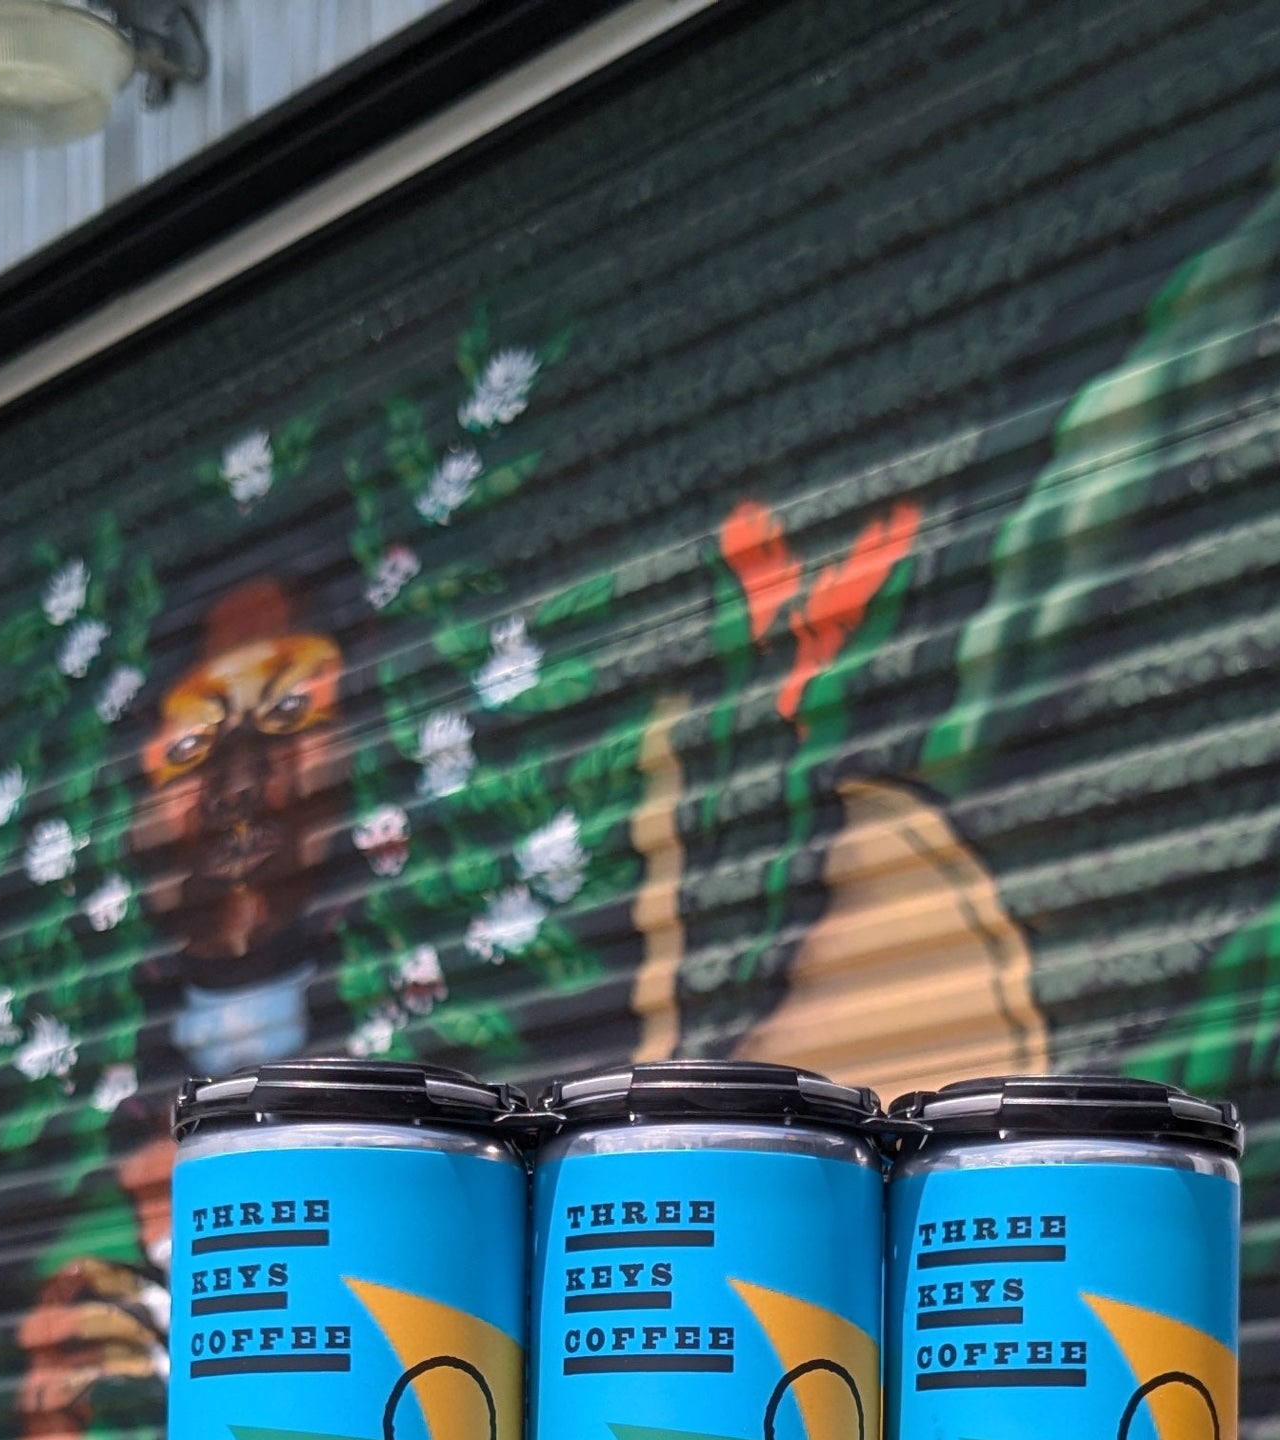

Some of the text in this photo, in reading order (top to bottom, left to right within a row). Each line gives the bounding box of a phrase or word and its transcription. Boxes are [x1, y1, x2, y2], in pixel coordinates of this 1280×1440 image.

[192, 1199, 330, 1231] THREE
[567, 1200, 715, 1229] THREE
[918, 1215, 1066, 1246] THREE
[192, 1262, 289, 1294] KEYS
[566, 1262, 673, 1291] KEYS
[917, 1278, 1024, 1308] KEYS
[191, 1326, 352, 1356] COFFEE
[564, 1326, 734, 1353] COFFEE
[917, 1341, 1087, 1369] COFFEE
